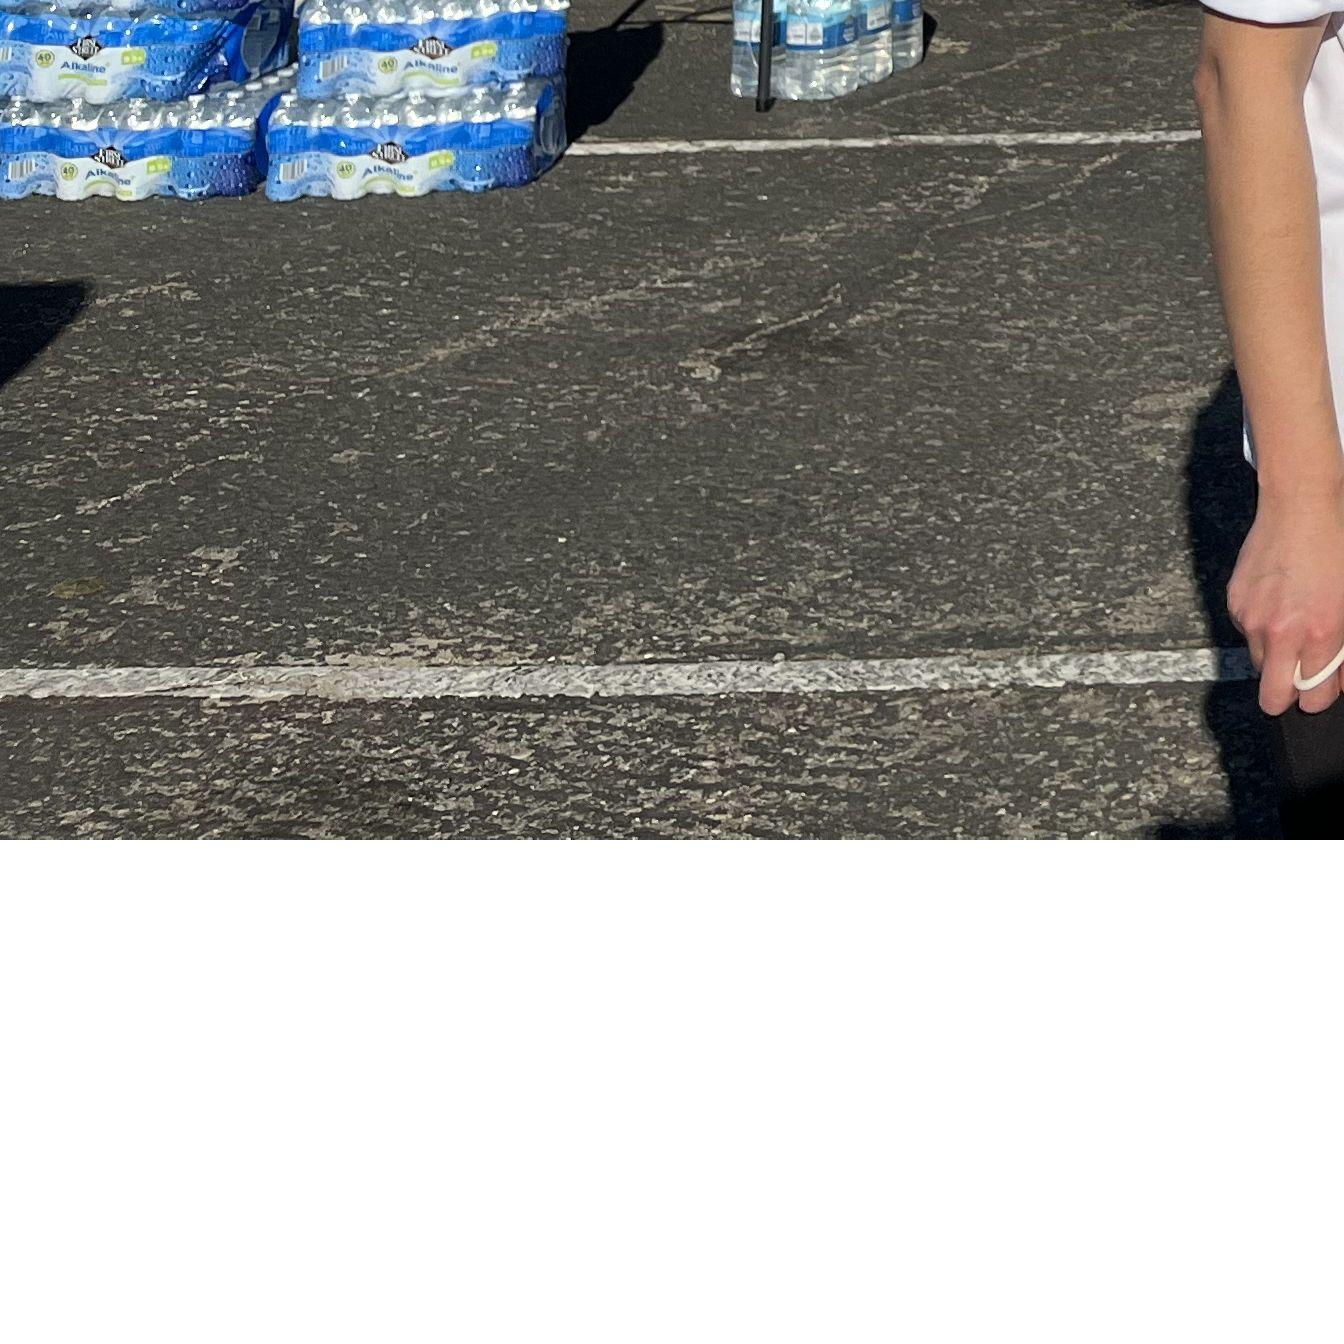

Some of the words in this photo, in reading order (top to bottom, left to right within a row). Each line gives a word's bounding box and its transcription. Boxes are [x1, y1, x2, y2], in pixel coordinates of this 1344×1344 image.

[61, 61, 106, 73] Alkaline
[404, 59, 458, 73] Alkaline
[84, 169, 131, 186] Alkaline
[362, 165, 413, 181] Alkaline
